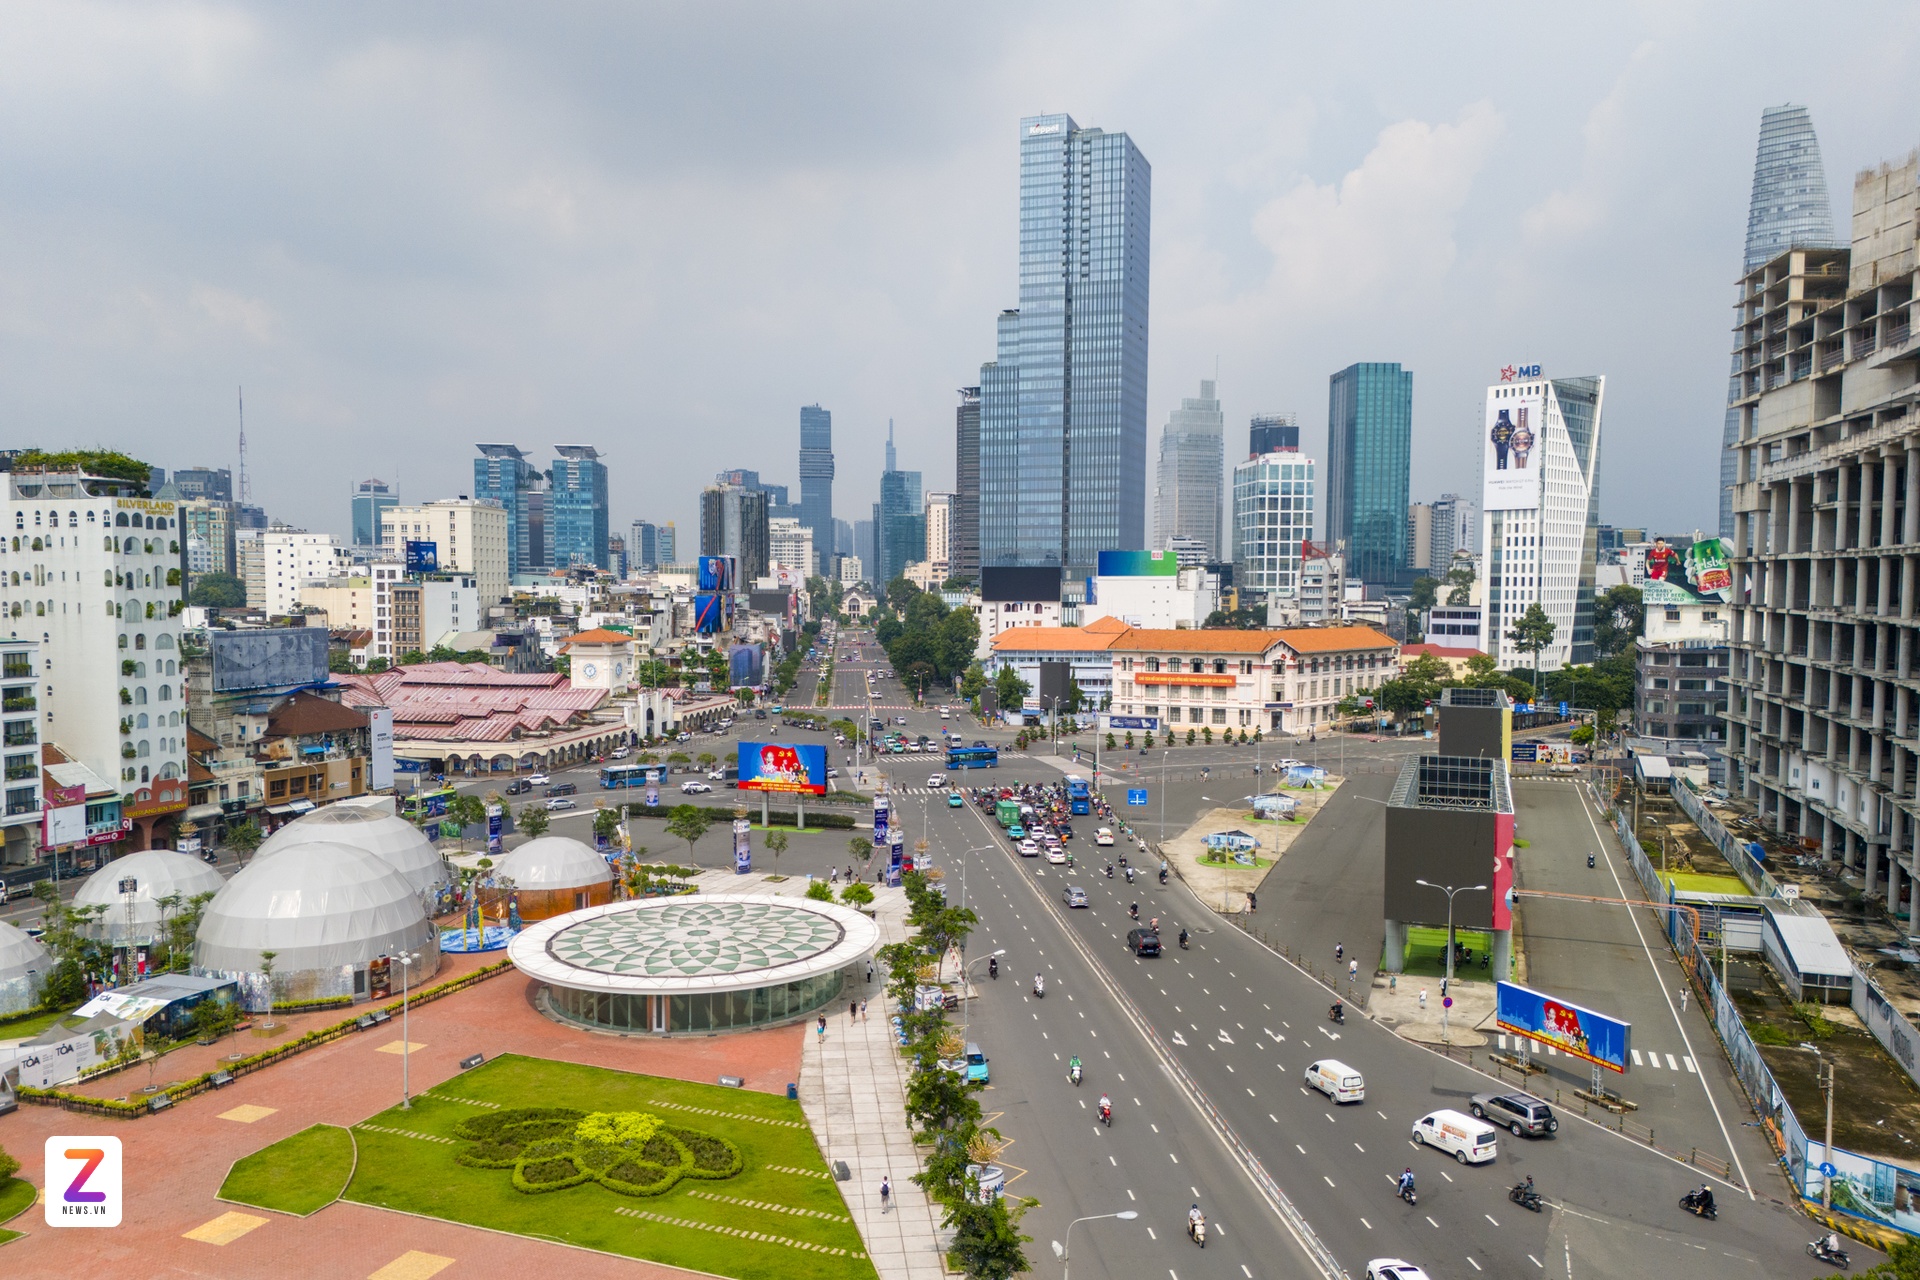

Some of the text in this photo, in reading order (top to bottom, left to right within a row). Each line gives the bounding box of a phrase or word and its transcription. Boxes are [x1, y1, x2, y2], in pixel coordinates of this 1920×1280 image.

[1030, 124, 1059, 134] Keppel
[1518, 365, 1541, 378] MB
[116, 498, 174, 510] SILVERLAND
[126, 808, 156, 818] SILVERLAND
